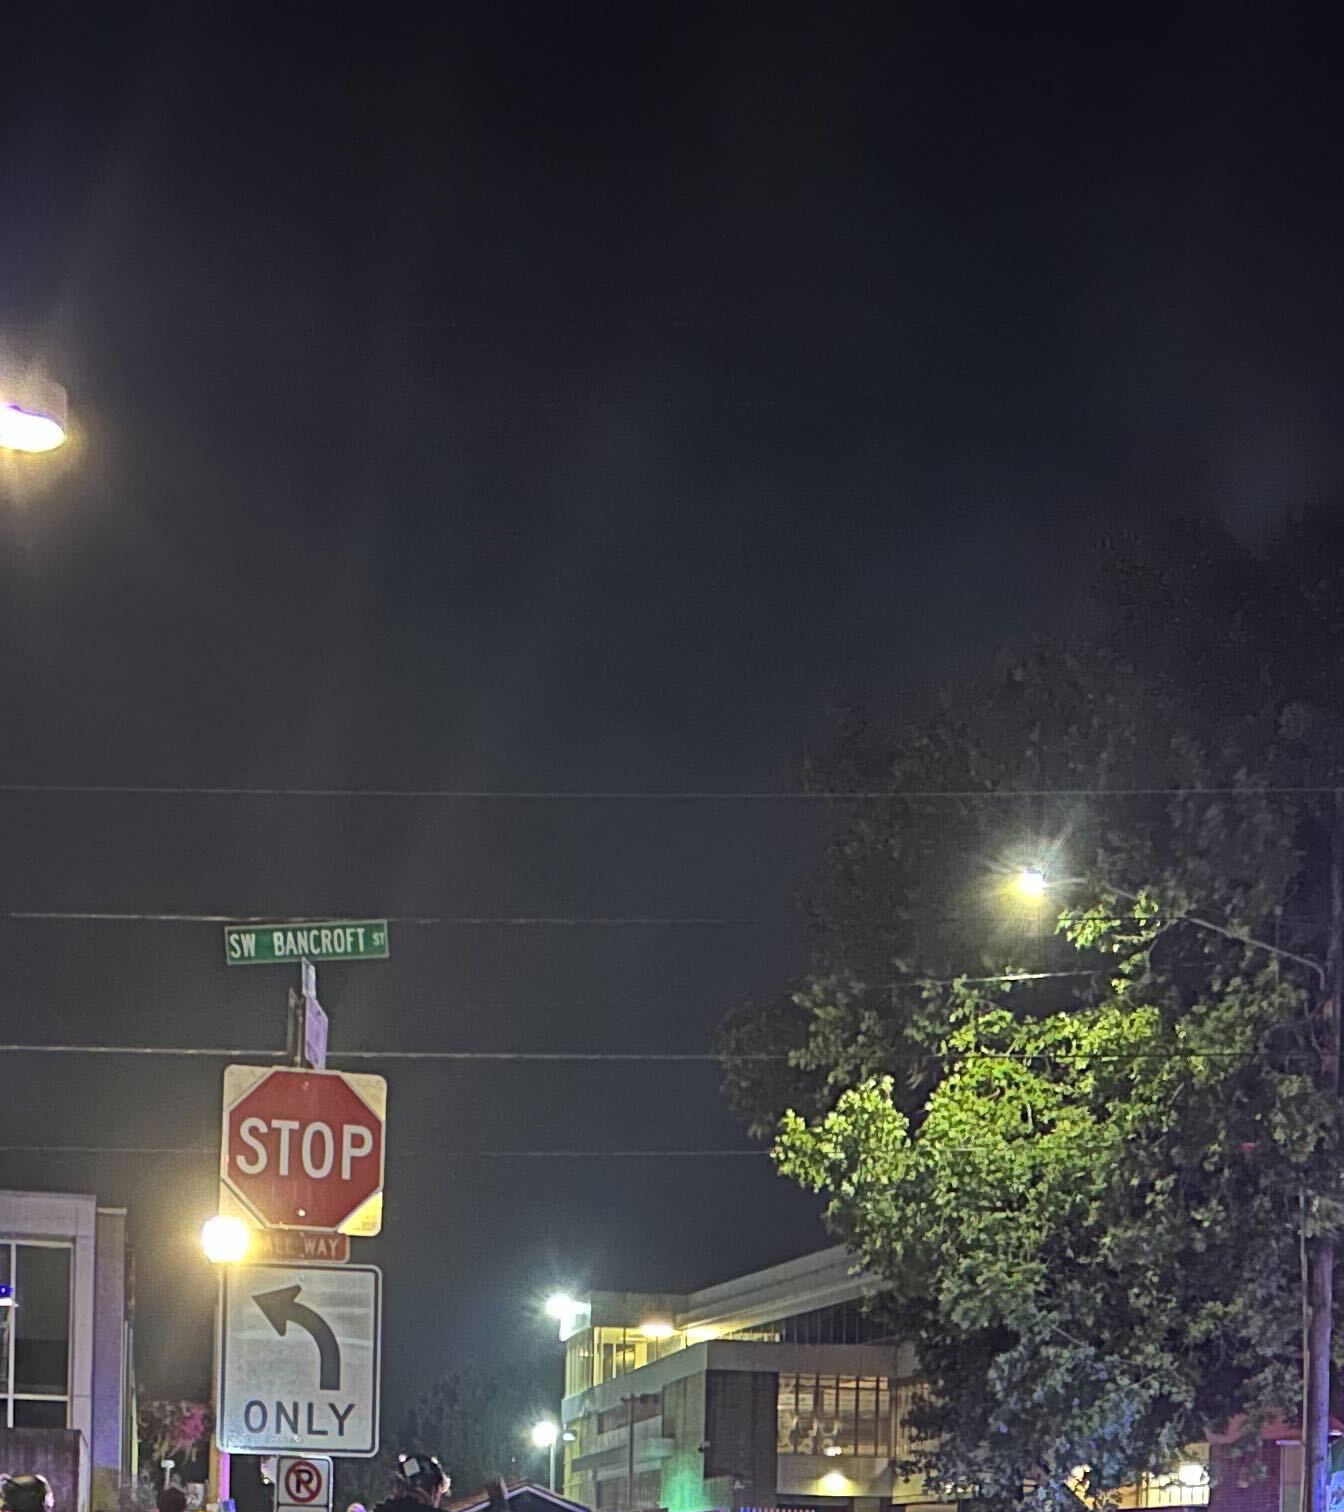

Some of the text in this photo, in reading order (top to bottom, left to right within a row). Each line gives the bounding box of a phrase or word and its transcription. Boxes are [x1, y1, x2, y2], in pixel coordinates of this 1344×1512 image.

[229, 928, 385, 958] SW BANCROFT ST
[236, 1117, 373, 1180] STOP
[304, 1238, 338, 1257] WAY
[244, 1400, 356, 1437] ONLY
